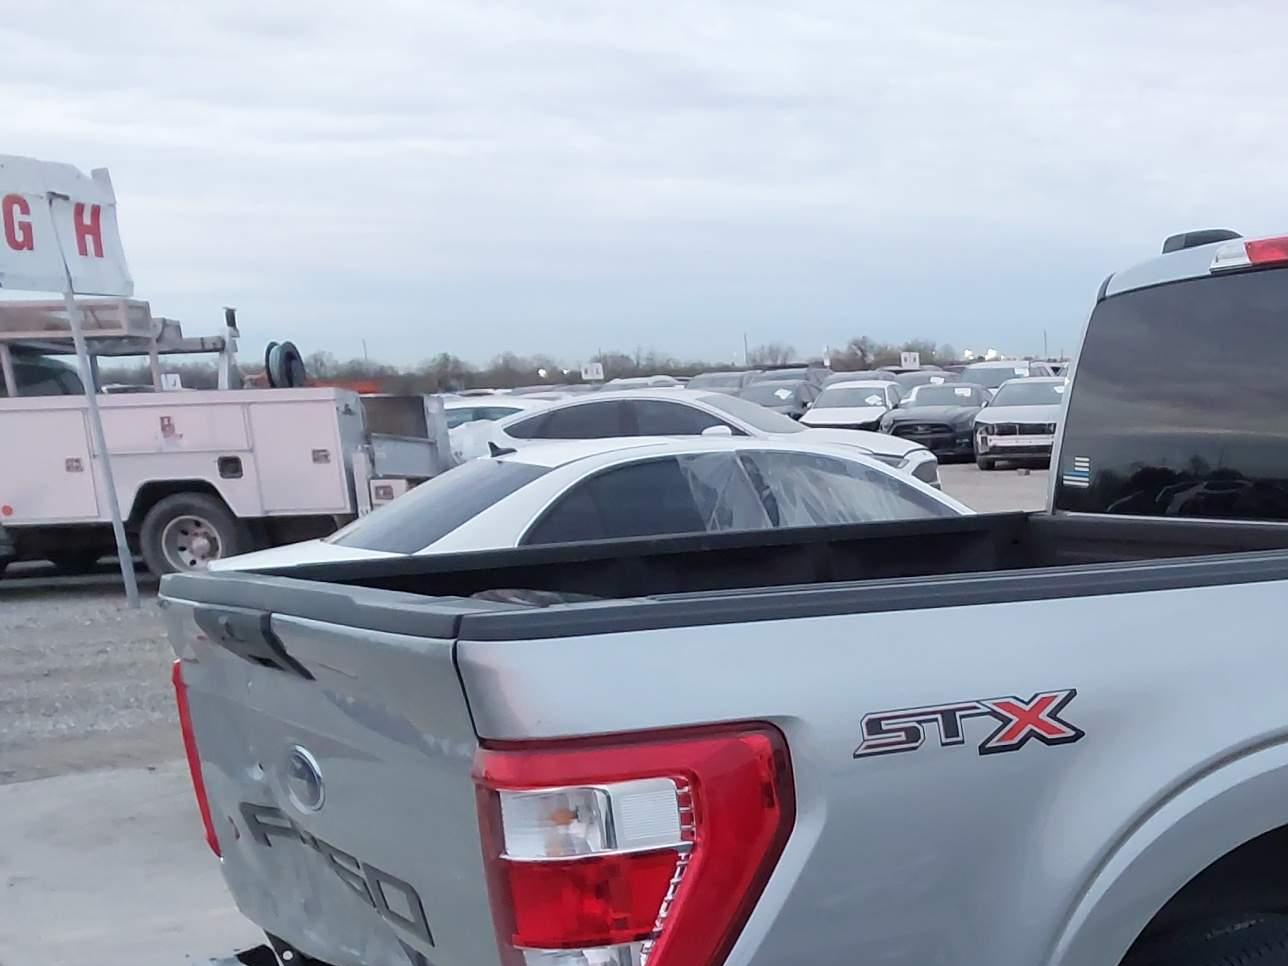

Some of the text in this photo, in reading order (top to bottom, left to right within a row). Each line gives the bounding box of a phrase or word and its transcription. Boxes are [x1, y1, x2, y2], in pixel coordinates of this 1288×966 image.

[2, 194, 104, 258] G H
[852, 688, 1086, 760] STX
